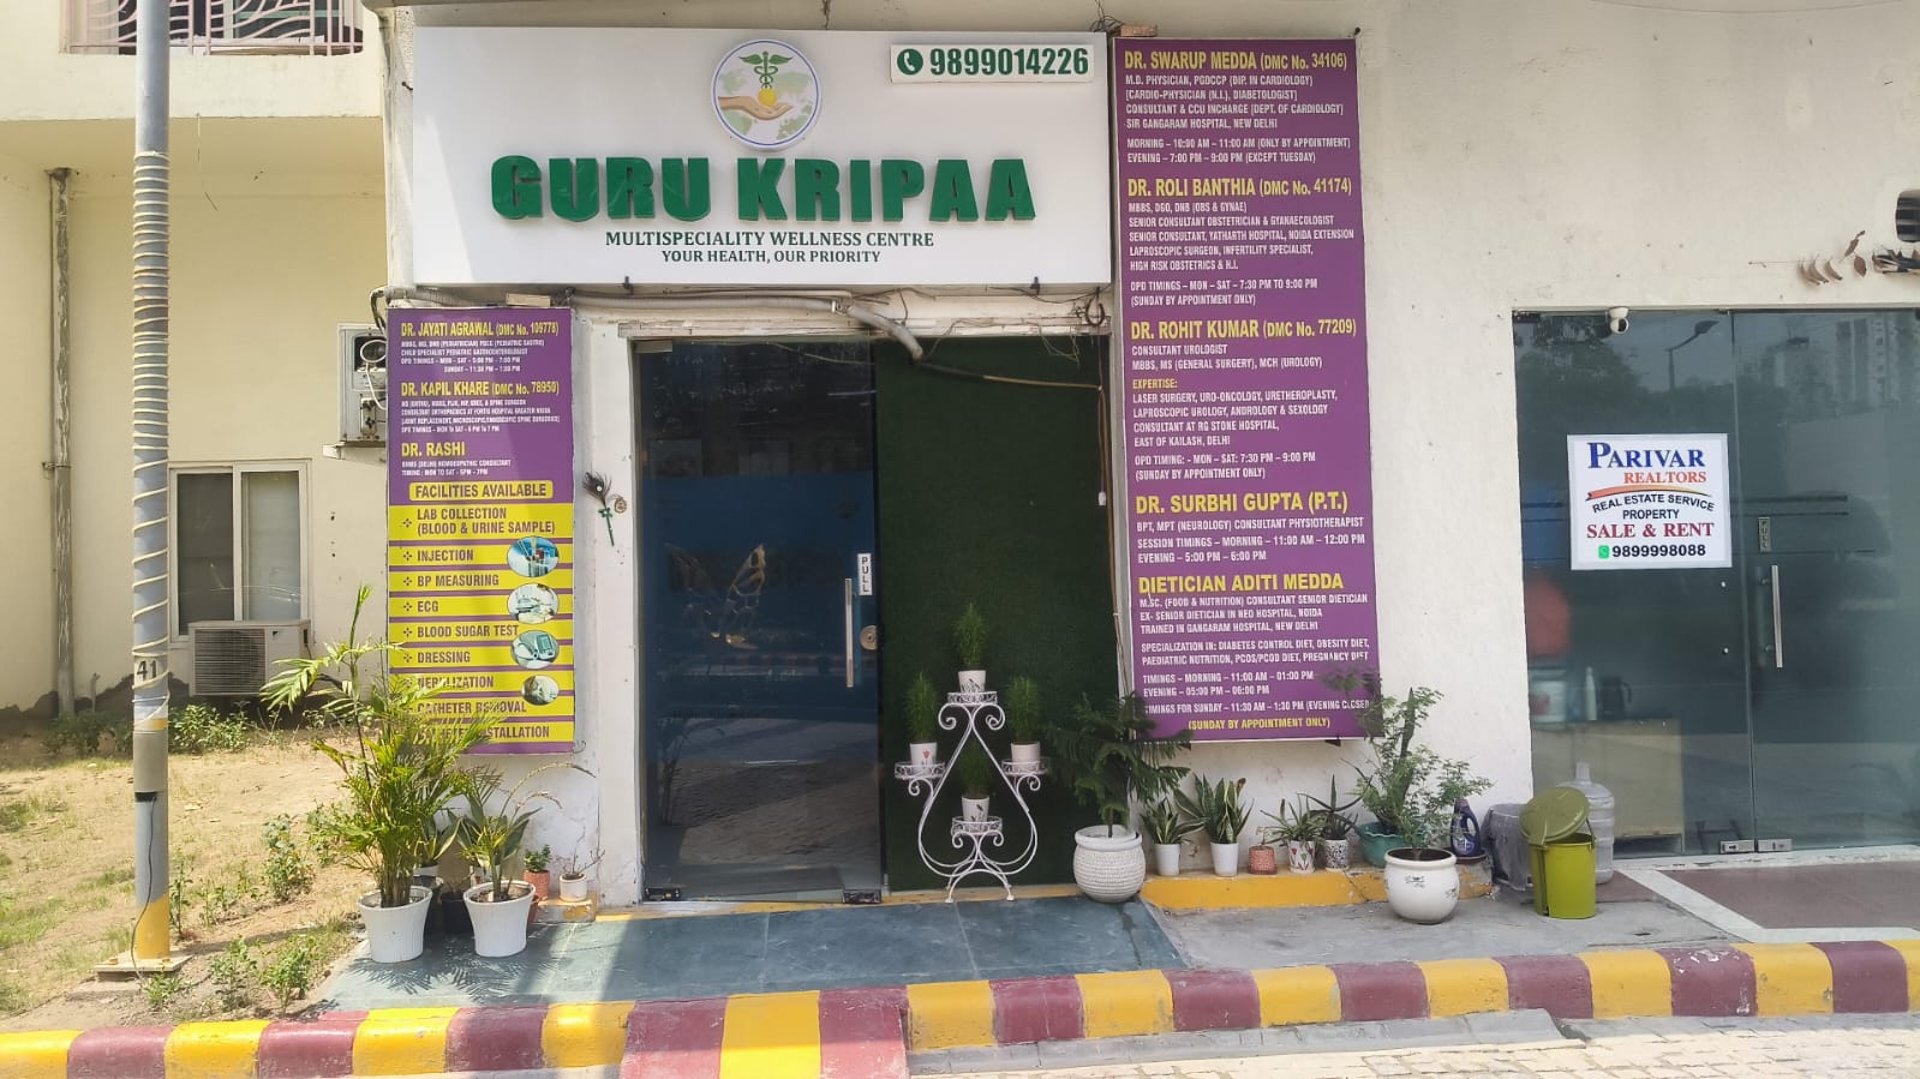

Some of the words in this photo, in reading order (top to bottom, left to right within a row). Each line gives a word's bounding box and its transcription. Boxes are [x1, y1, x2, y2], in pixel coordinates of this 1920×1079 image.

[929, 47, 1088, 76] 9899014226
[1124, 51, 1146, 69] DR.
[1150, 51, 1206, 70] SWARUP
[1210, 52, 1257, 70] MEDDA
[1260, 55, 1288, 70] (DMC
[1291, 55, 1309, 70] No.
[1311, 53, 1346, 71] 34106)
[491, 156, 710, 223] GURU
[737, 158, 1036, 223] KRIPAA
[1127, 179, 1151, 197] DR.
[1155, 178, 1188, 197] ROLI
[1192, 178, 1256, 196] BANTHIA
[1259, 180, 1289, 196] (DMC
[1292, 181, 1311, 195] No.
[1313, 178, 1351, 196] 41174)
[605, 231, 764, 246] MULTISPECIALITY
[769, 232, 861, 246] WELLNESS
[866, 233, 933, 247] CENTRE
[662, 250, 702, 262] YOUR
[708, 250, 769, 262] HEALTH,
[774, 251, 804, 262] OUR
[810, 251, 879, 263] PRIORITY
[1130, 296, 1164, 306] (SUNDAY
[1165, 295, 1176, 306] BY
[1177, 294, 1232, 305] APPOINTMENT
[1233, 294, 1256, 305] ONLY)
[1130, 322, 1154, 340] DR.
[1158, 321, 1202, 339] ROHIT
[1206, 320, 1259, 338] KUMAR
[1262, 322, 1293, 337] (DMC
[1296, 322, 1315, 337] No.
[1317, 319, 1356, 337] 77209)
[1132, 345, 1180, 356] CONSULTANT
[1184, 344, 1226, 355] UROLOGIST
[1132, 378, 1177, 389] EXPERTISE:
[1134, 437, 1154, 447] EAST
[1155, 437, 1166, 447] OF
[1168, 436, 1205, 446] KAILASH,
[1206, 435, 1230, 446] DELHI
[401, 443, 422, 457] DR.
[426, 442, 465, 457] RASHI
[1587, 442, 1705, 468] PARIVAR
[1624, 472, 1707, 483] REALTORS
[416, 484, 477, 498] FACILITIES
[483, 483, 547, 498] AVAILABLE
[1136, 496, 1164, 514] DR.
[1170, 494, 1237, 513] SURBHI
[1243, 492, 1302, 511] GUPTA
[1308, 491, 1347, 515] (P.T.)
[1592, 498, 1622, 513] REAL
[1624, 494, 1665, 505] ESTATE
[1667, 494, 1715, 512] SERVICE
[416, 509, 437, 521] LAB
[440, 508, 506, 520] COLLECTION
[1622, 509, 1679, 520] PROPERTY
[417, 523, 456, 536] (BLOOD
[460, 522, 467, 534] &
[472, 522, 503, 534] URINE
[508, 521, 555, 535] SAMPLE)
[1137, 522, 1154, 533] BPT,
[1157, 521, 1174, 531] MPT
[1177, 520, 1231, 531] (NEUROLOGY)
[1234, 519, 1286, 530] CONSULTANT
[1288, 517, 1362, 529] PHYSIOTHERAPIST
[1587, 524, 1634, 539] SALE
[1643, 524, 1655, 538] &
[1664, 523, 1714, 537] RENT
[417, 549, 474, 562] INJECTION
[1611, 544, 1706, 558] 9899998088
[417, 575, 431, 587] BP
[435, 574, 499, 587] MEASURING
[861, 556, 870, 592] PULL
[1138, 575, 1226, 594] DIETICIAN
[1231, 574, 1278, 591] ADITI
[1283, 573, 1344, 590] MEDDA
[417, 600, 438, 613] ECG
[417, 626, 451, 638] BLOOD
[455, 625, 490, 637] SUGAR
[493, 624, 519, 636] TEST
[417, 651, 470, 664] DRESSING
[136, 660, 157, 681] 41
[1188, 720, 1225, 730] (SUNDAY
[1227, 720, 1238, 729] BY
[1240, 718, 1303, 729] APPOINTMENT
[1305, 717, 1330, 727] ONLY)
[480, 726, 550, 738] STALLATION
